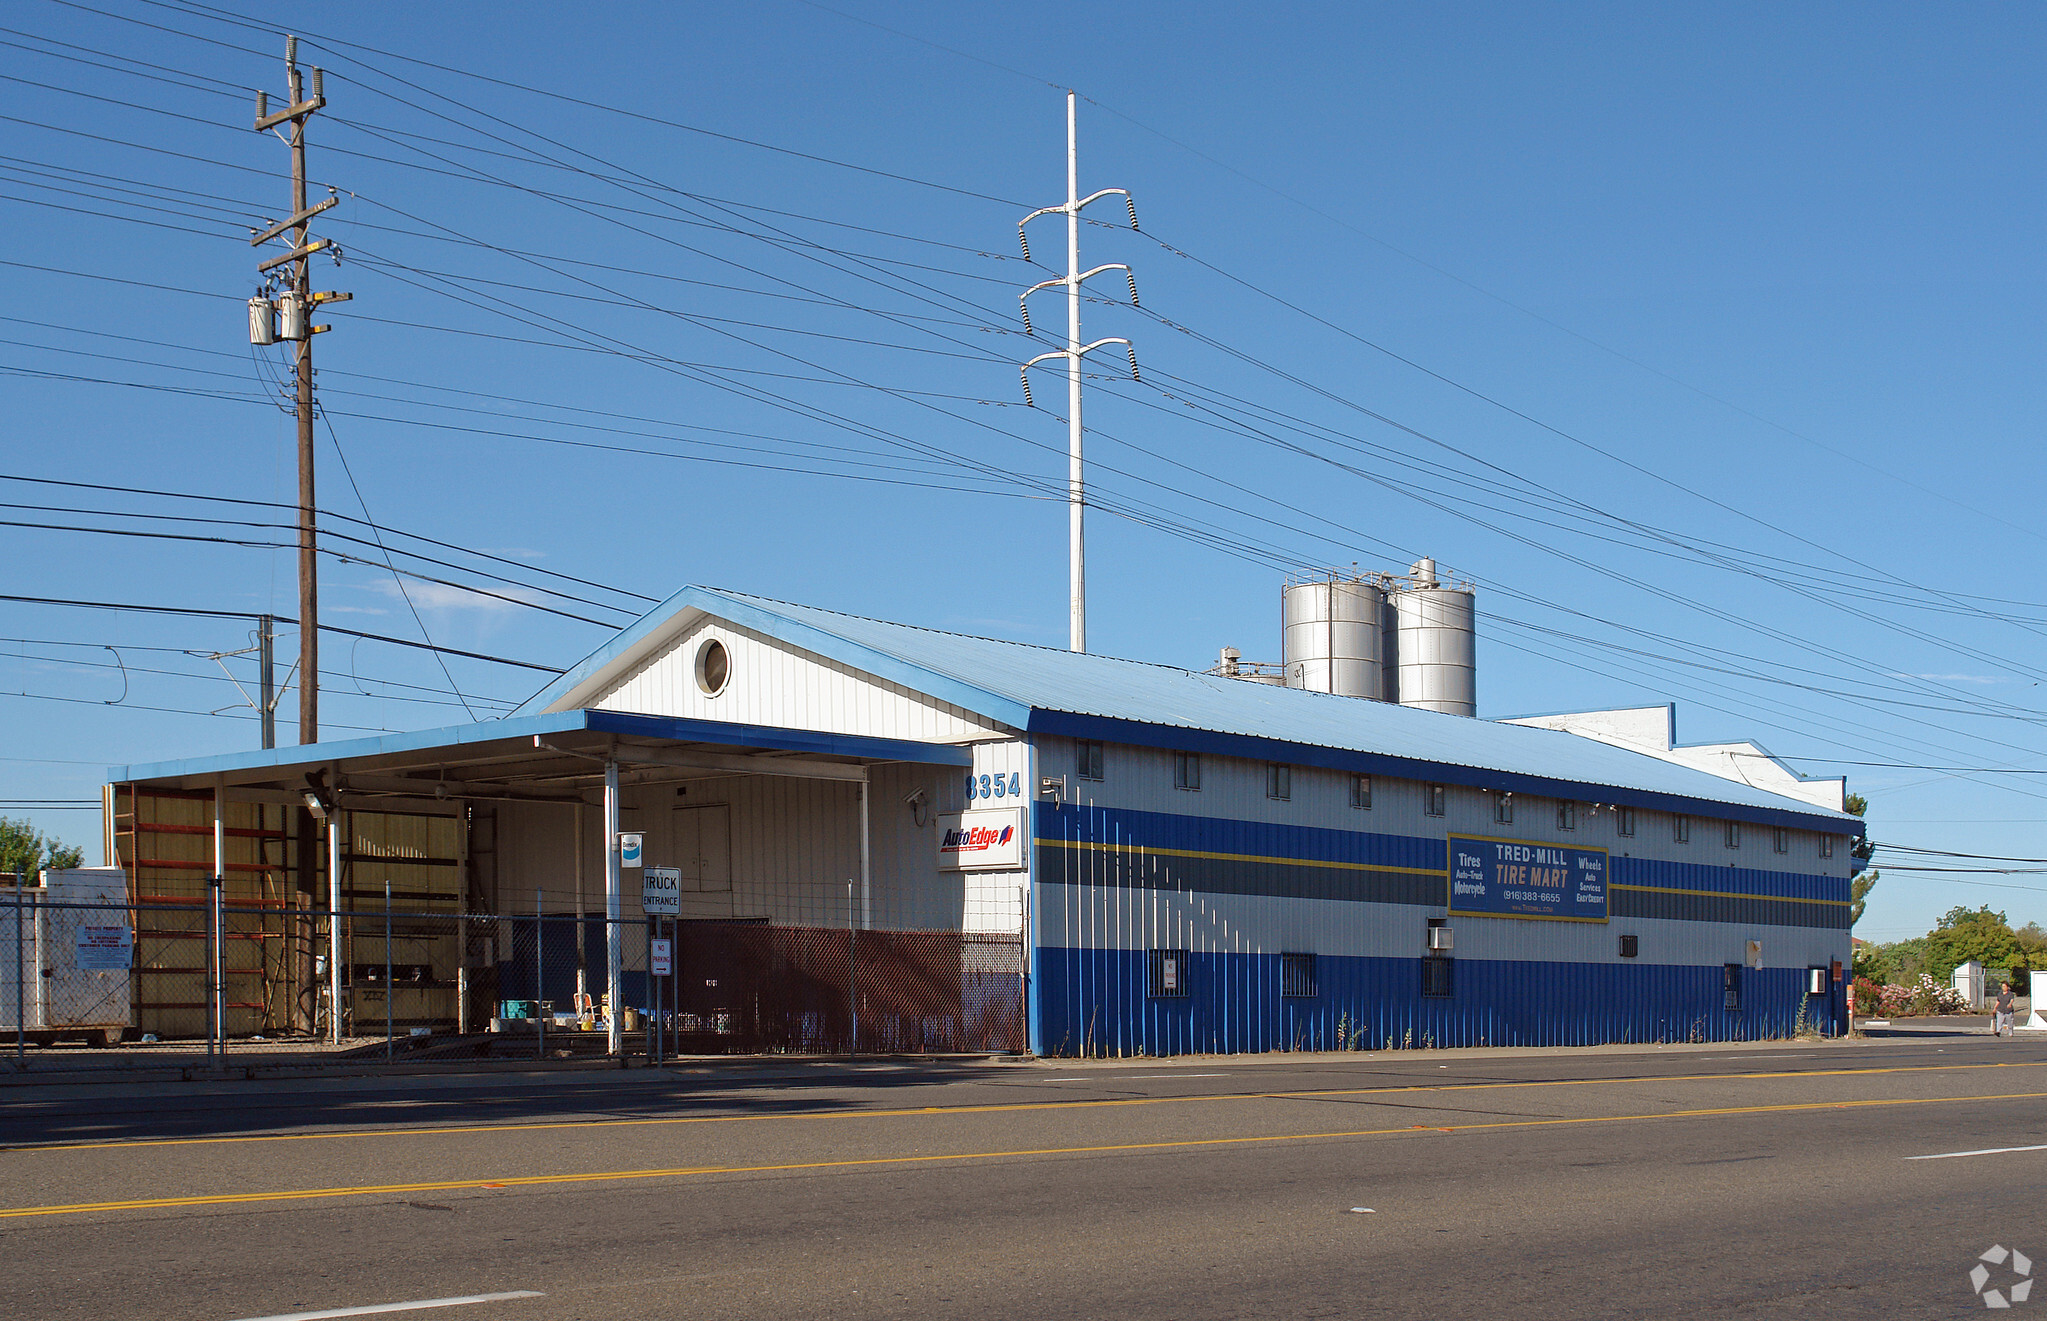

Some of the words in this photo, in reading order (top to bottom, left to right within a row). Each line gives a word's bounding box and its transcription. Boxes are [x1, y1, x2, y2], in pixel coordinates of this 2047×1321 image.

[966, 772, 1020, 800] 8354
[942, 826, 999, 850] AutoEdge
[1458, 853, 1481, 868] Tires
[1578, 857, 1602, 871] Wheels
[645, 876, 677, 890] TRUCK
[1496, 864, 1527, 885] TIRE
[1530, 867, 1568, 888] MART
[1585, 872, 1596, 882] Auto
[1454, 881, 1486, 898] Motorcycle
[1579, 882, 1601, 892] Services
[643, 896, 678, 906] ENTRANCE
[658, 944, 664, 952] NO
